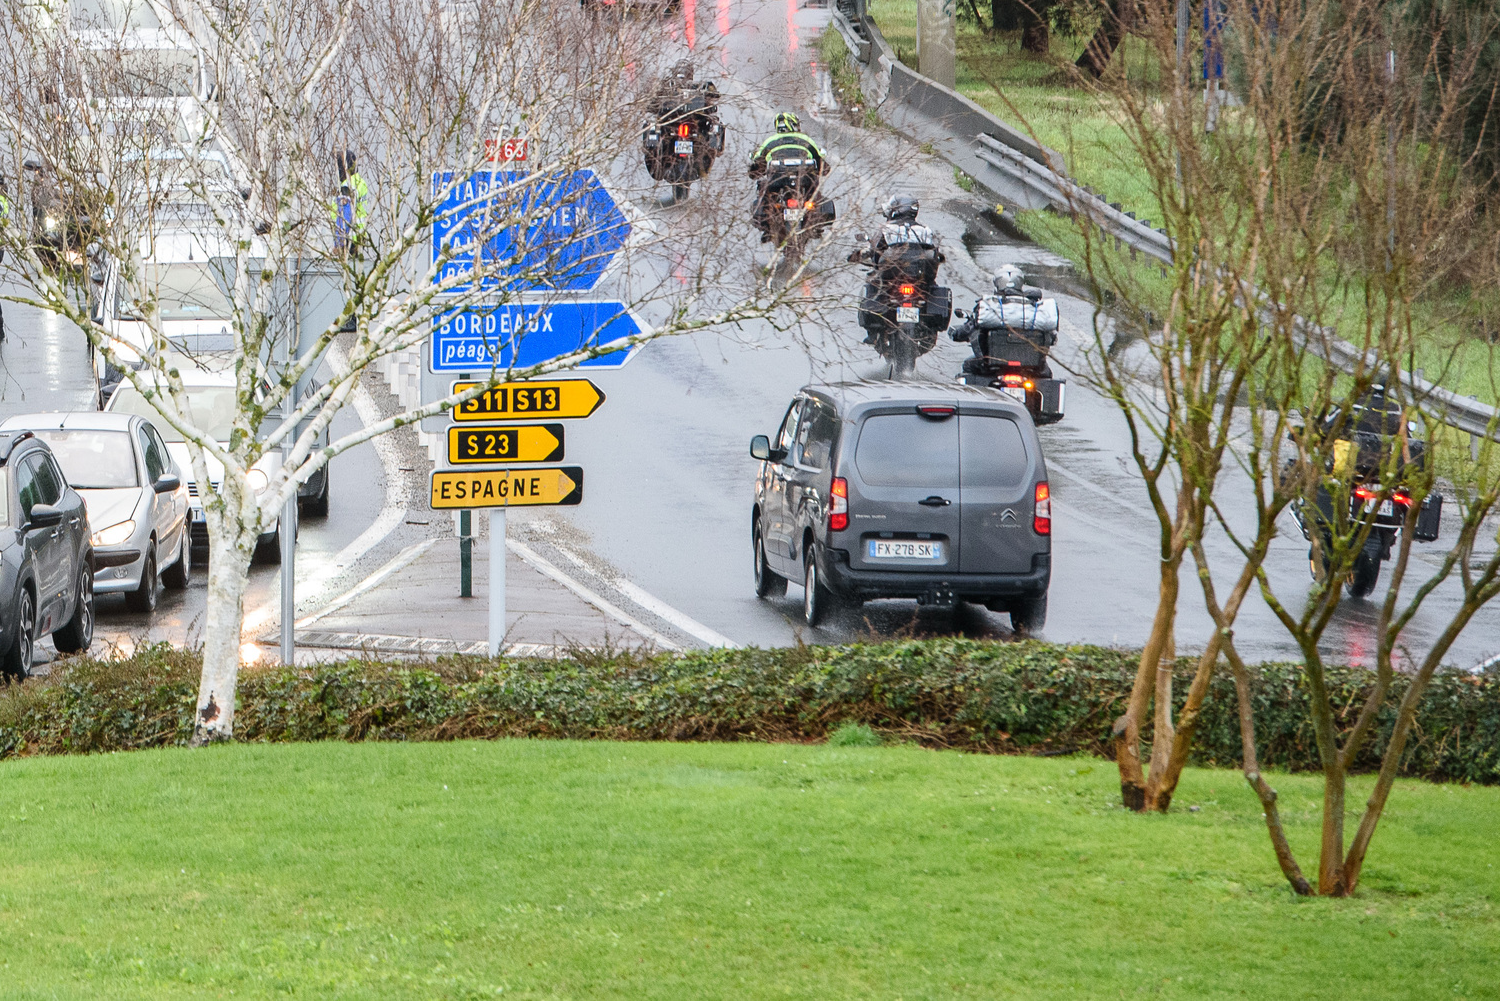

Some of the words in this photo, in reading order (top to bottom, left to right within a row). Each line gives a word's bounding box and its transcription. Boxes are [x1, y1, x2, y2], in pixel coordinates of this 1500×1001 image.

[440, 313, 553, 335] BORDEAUX
[445, 341, 497, 362] péage
[484, 434, 510, 455] 23
[441, 477, 541, 500] ESPAGNE
